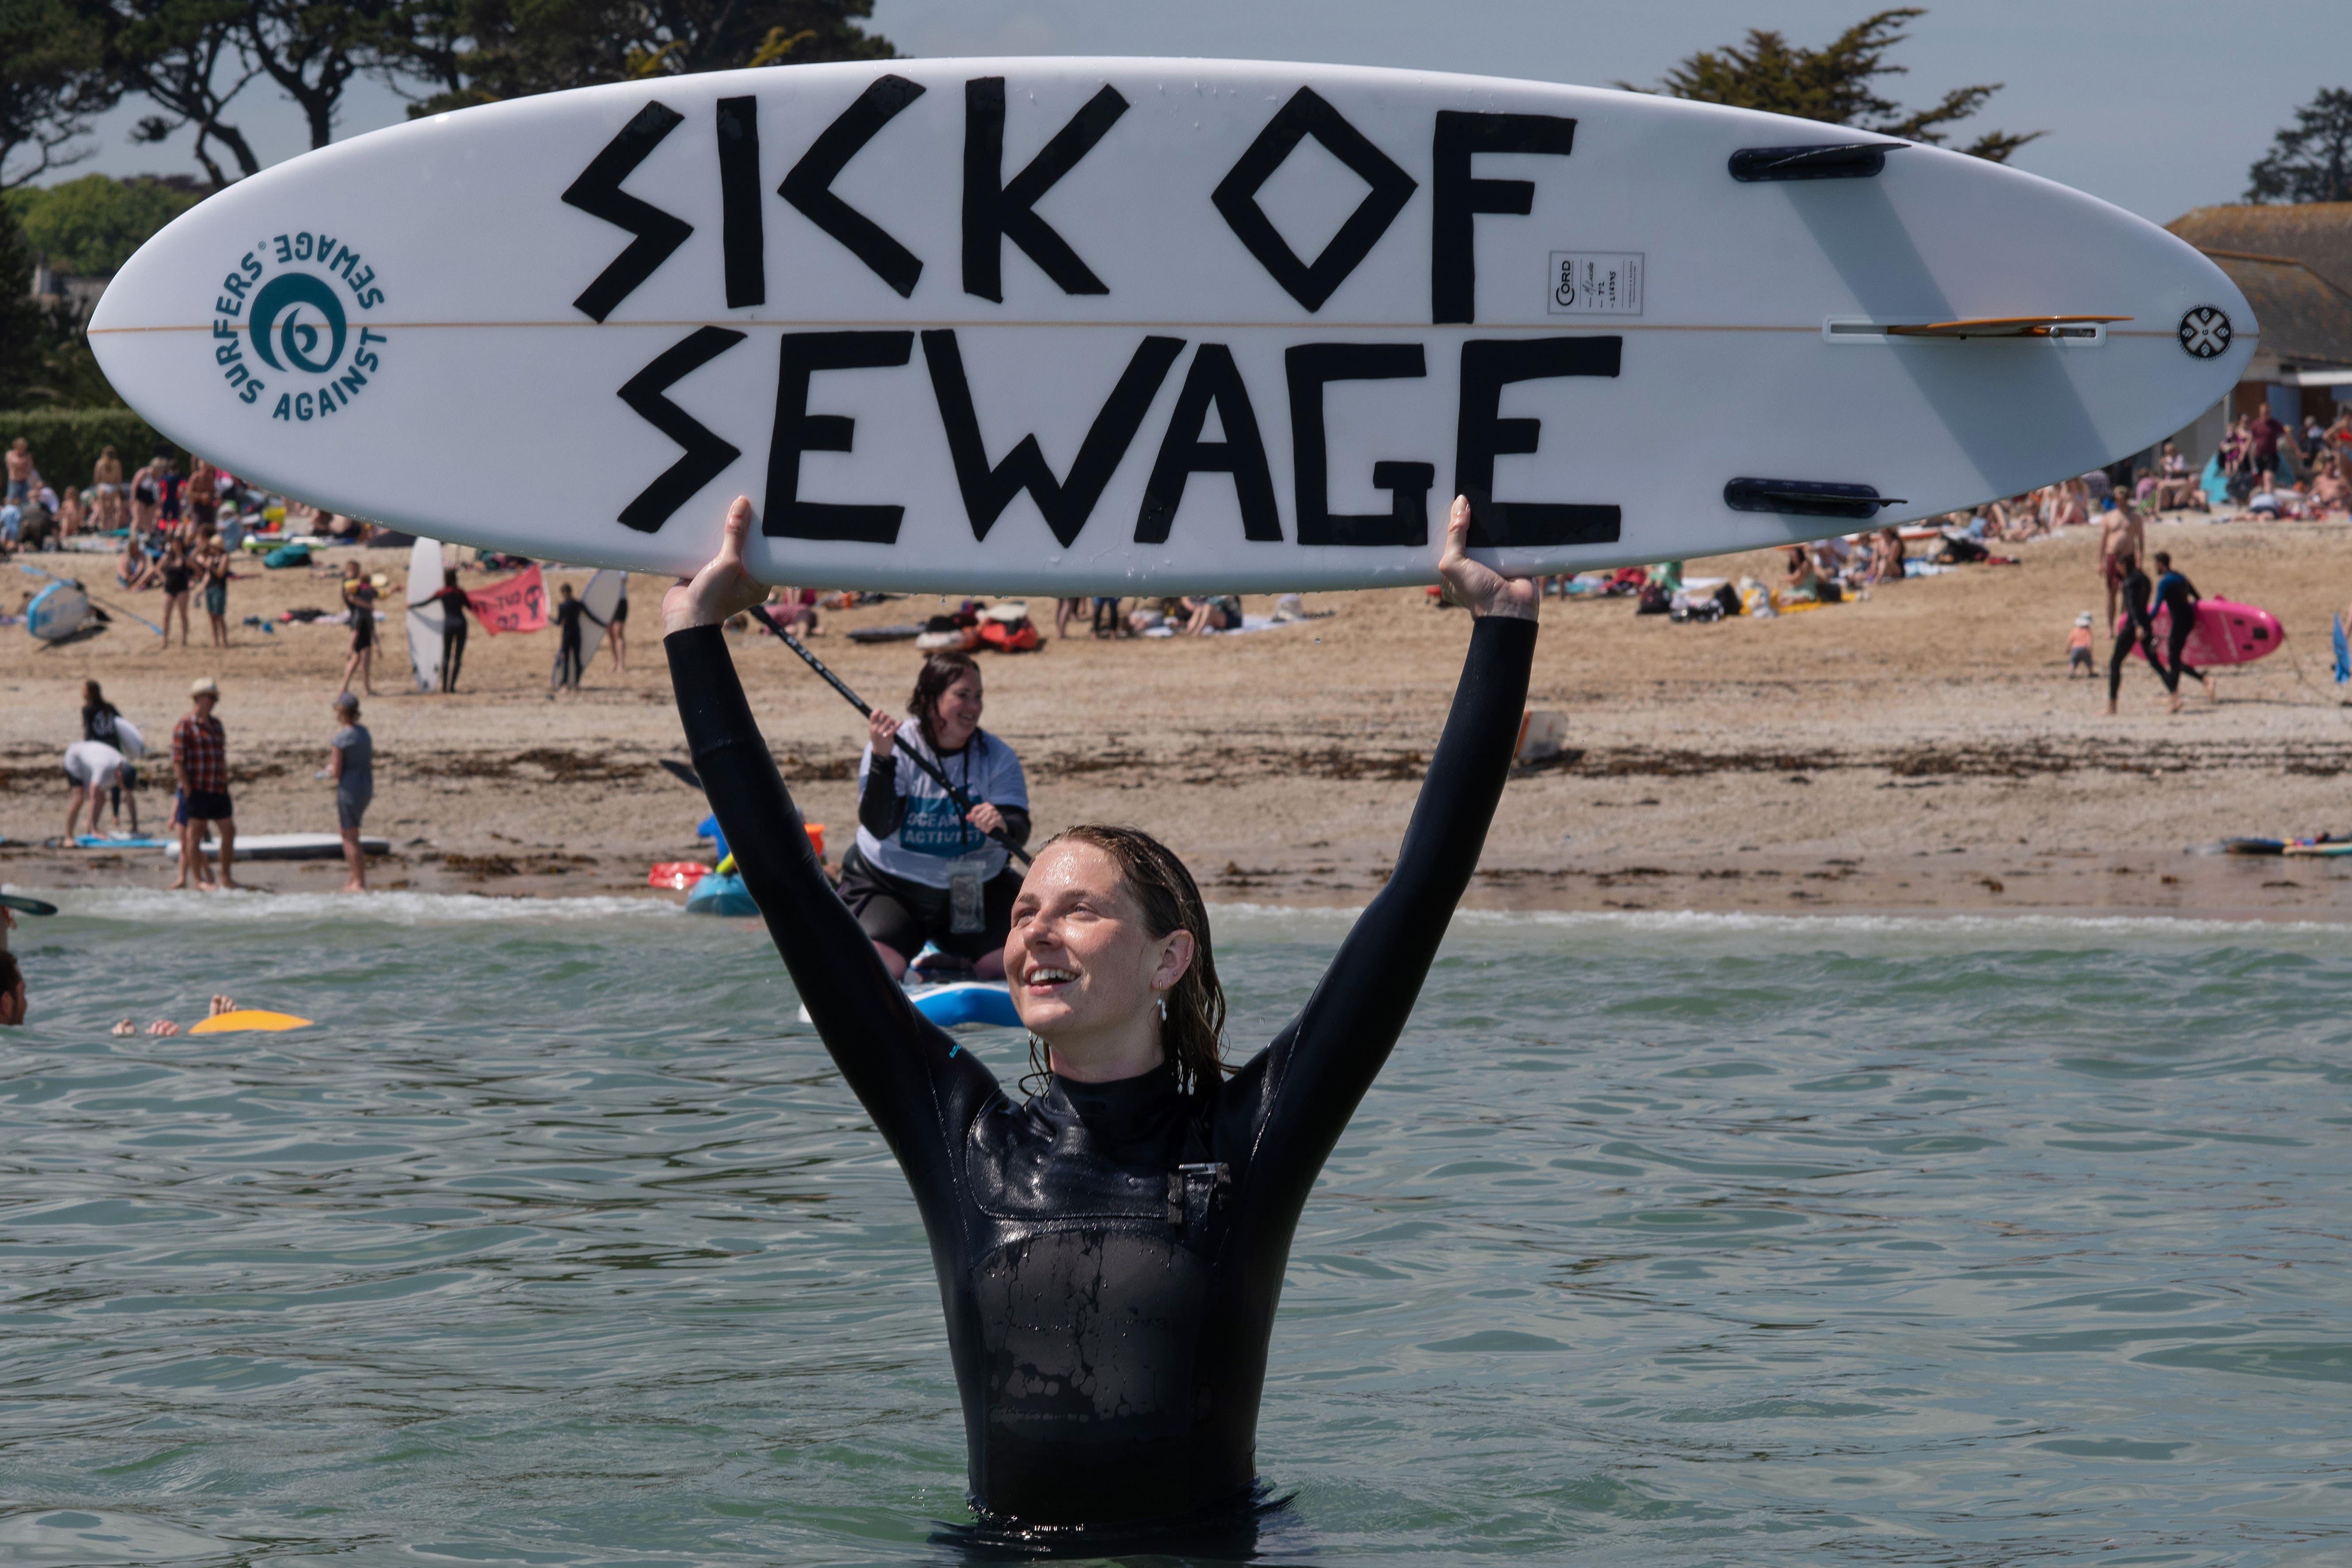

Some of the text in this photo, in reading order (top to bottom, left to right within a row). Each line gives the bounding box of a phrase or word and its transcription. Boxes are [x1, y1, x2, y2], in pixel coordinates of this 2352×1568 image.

[561, 75, 1577, 325] SICK OF
[1556, 260, 1575, 305] CORD
[212, 231, 388, 421] SURFERS AGAINST SEWAGE
[617, 325, 1623, 549] SEWAGE
[907, 812, 961, 828] OCEAN
